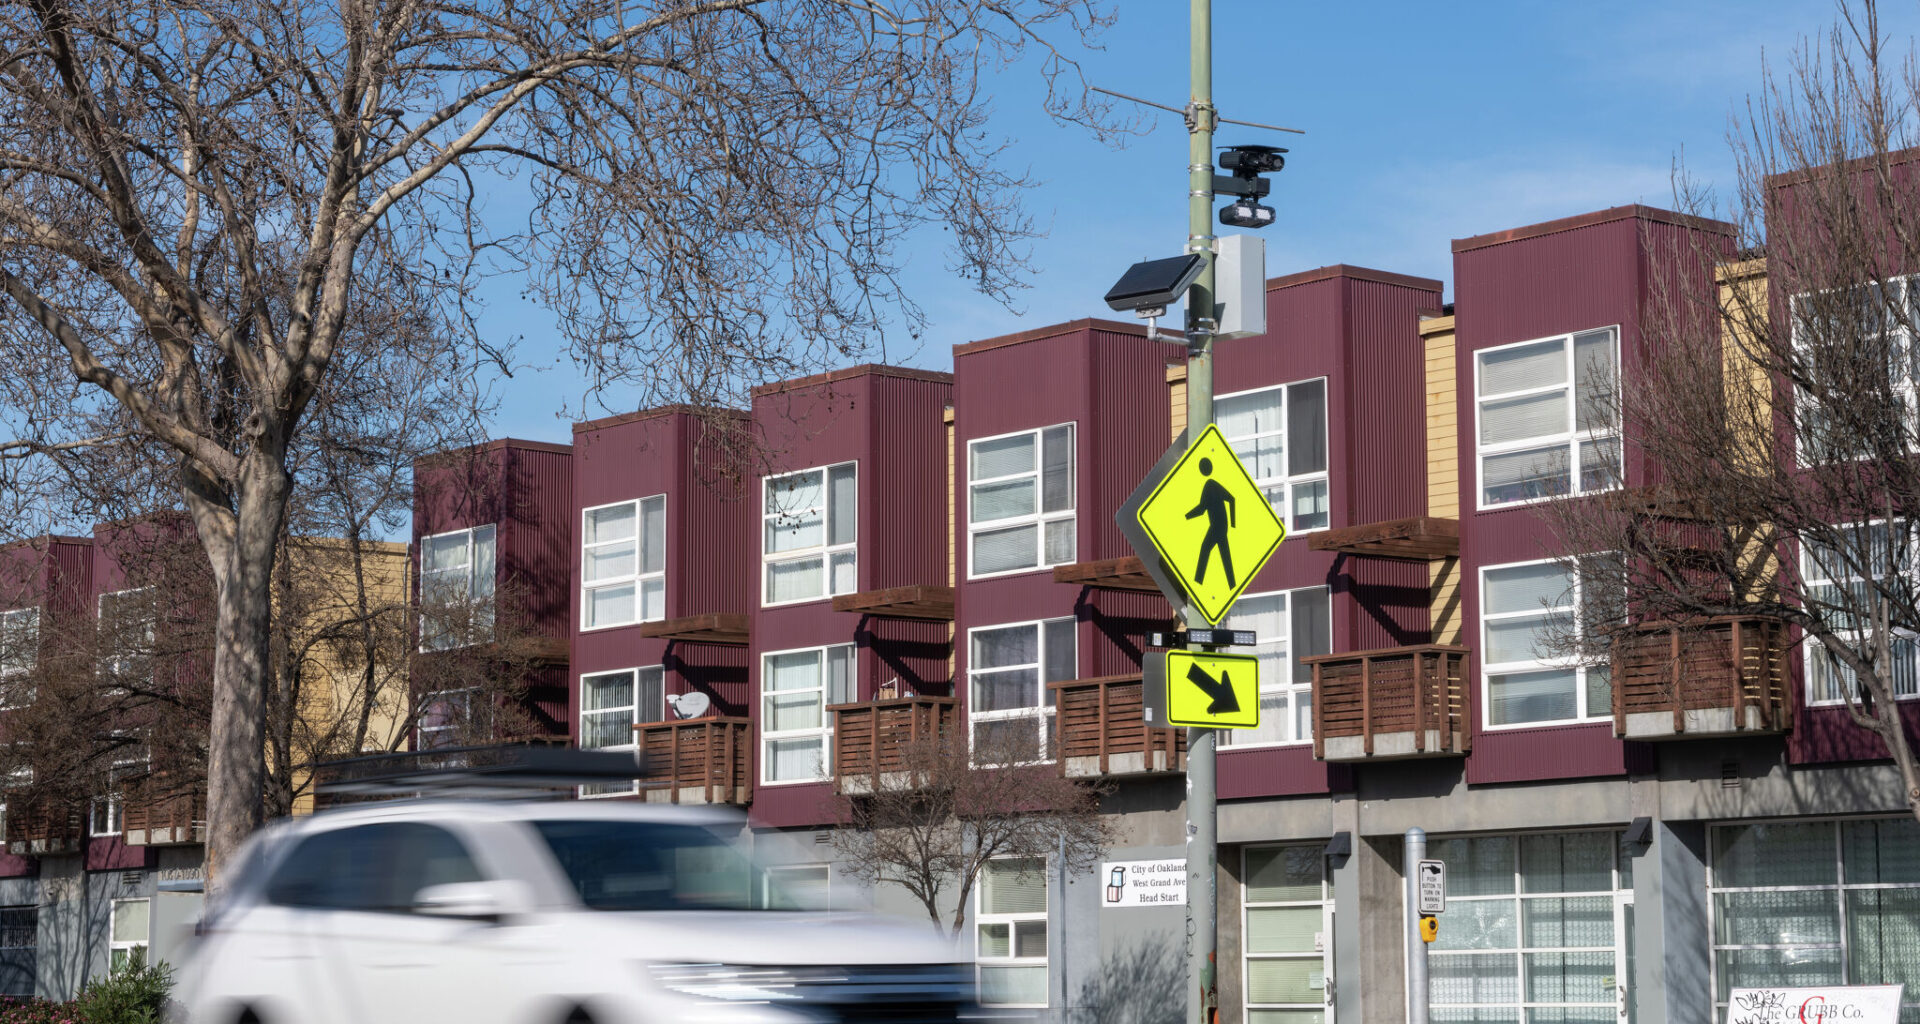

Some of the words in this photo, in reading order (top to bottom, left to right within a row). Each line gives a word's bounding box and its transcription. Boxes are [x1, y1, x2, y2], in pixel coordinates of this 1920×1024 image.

[1132, 865, 1146, 876] City
[1148, 864, 1155, 872] of
[1156, 863, 1187, 872] Oakland
[1132, 879, 1148, 887] West
[1150, 878, 1170, 886] Grand
[1173, 878, 1186, 886] Ave
[1140, 894, 1158, 902] Head
[1160, 892, 1179, 902] Start
[1786, 1004, 1838, 1020] GRUBB
[1842, 1004, 1864, 1018] Co.
